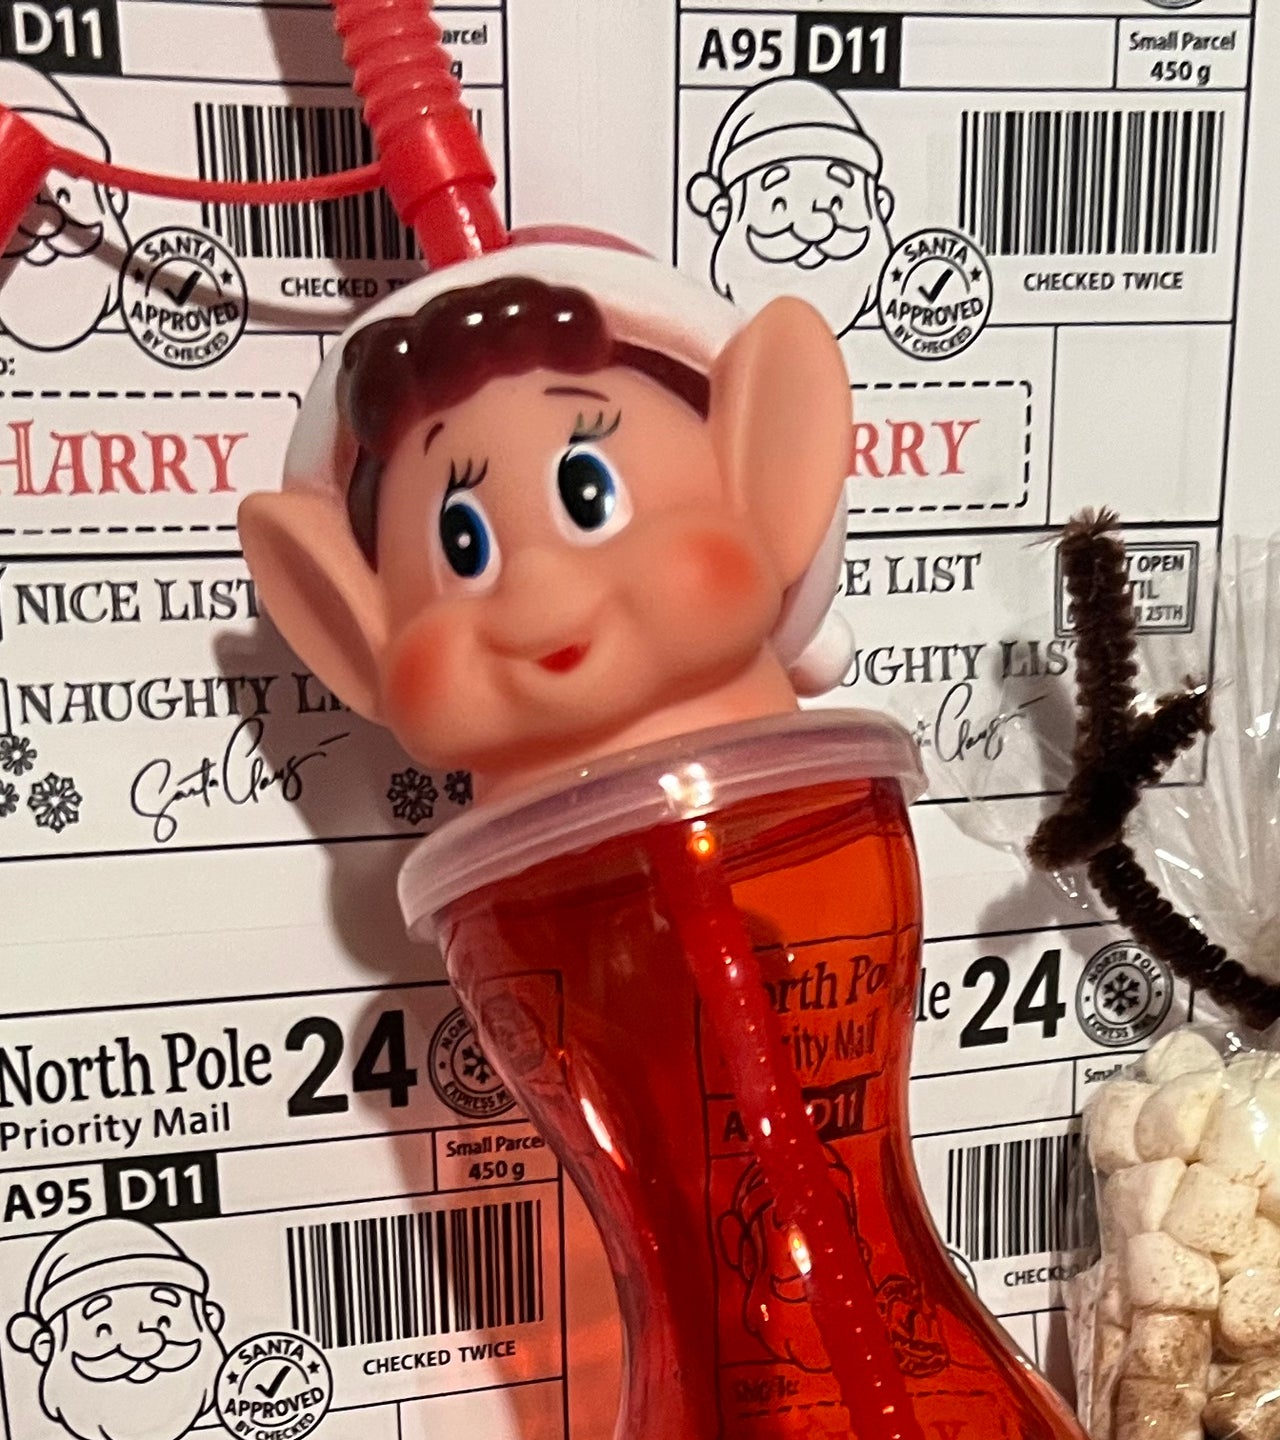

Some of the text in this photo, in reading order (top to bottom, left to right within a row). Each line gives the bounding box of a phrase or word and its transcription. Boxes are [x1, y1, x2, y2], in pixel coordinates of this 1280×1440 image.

[12, 2, 103, 59] D11
[697, 25, 1236, 76] A95 D11 Small Parcel
[1150, 59, 1212, 87] 450 g
[143, 235, 216, 268] SANTA
[904, 237, 968, 265] SANTA
[281, 277, 378, 298] CHECKED
[1023, 269, 1184, 292] CHECKED TWICE
[130, 300, 239, 331] APPROVED
[886, 297, 983, 327] APPROVED
[846, 418, 981, 478] RRY
[884, 553, 982, 596] LIST
[1137, 554, 1184, 573] OPEN
[15, 578, 260, 625] NICE LIST
[19, 673, 280, 726] NAUGHTY
[960, 948, 1066, 1048] 24
[161, 1027, 273, 1093] Pole
[284, 1009, 418, 1118] 24
[153, 1103, 232, 1140] Mail
[1, 1134, 546, 1224] A95 D11 Small Parce
[468, 1160, 525, 1181] 450 g
[238, 1339, 304, 1365] SANTA
[362, 1340, 516, 1376] CHECKED TWICE
[224, 1387, 324, 1418] APPROVED
[235, 1420, 255, 1436] BY
